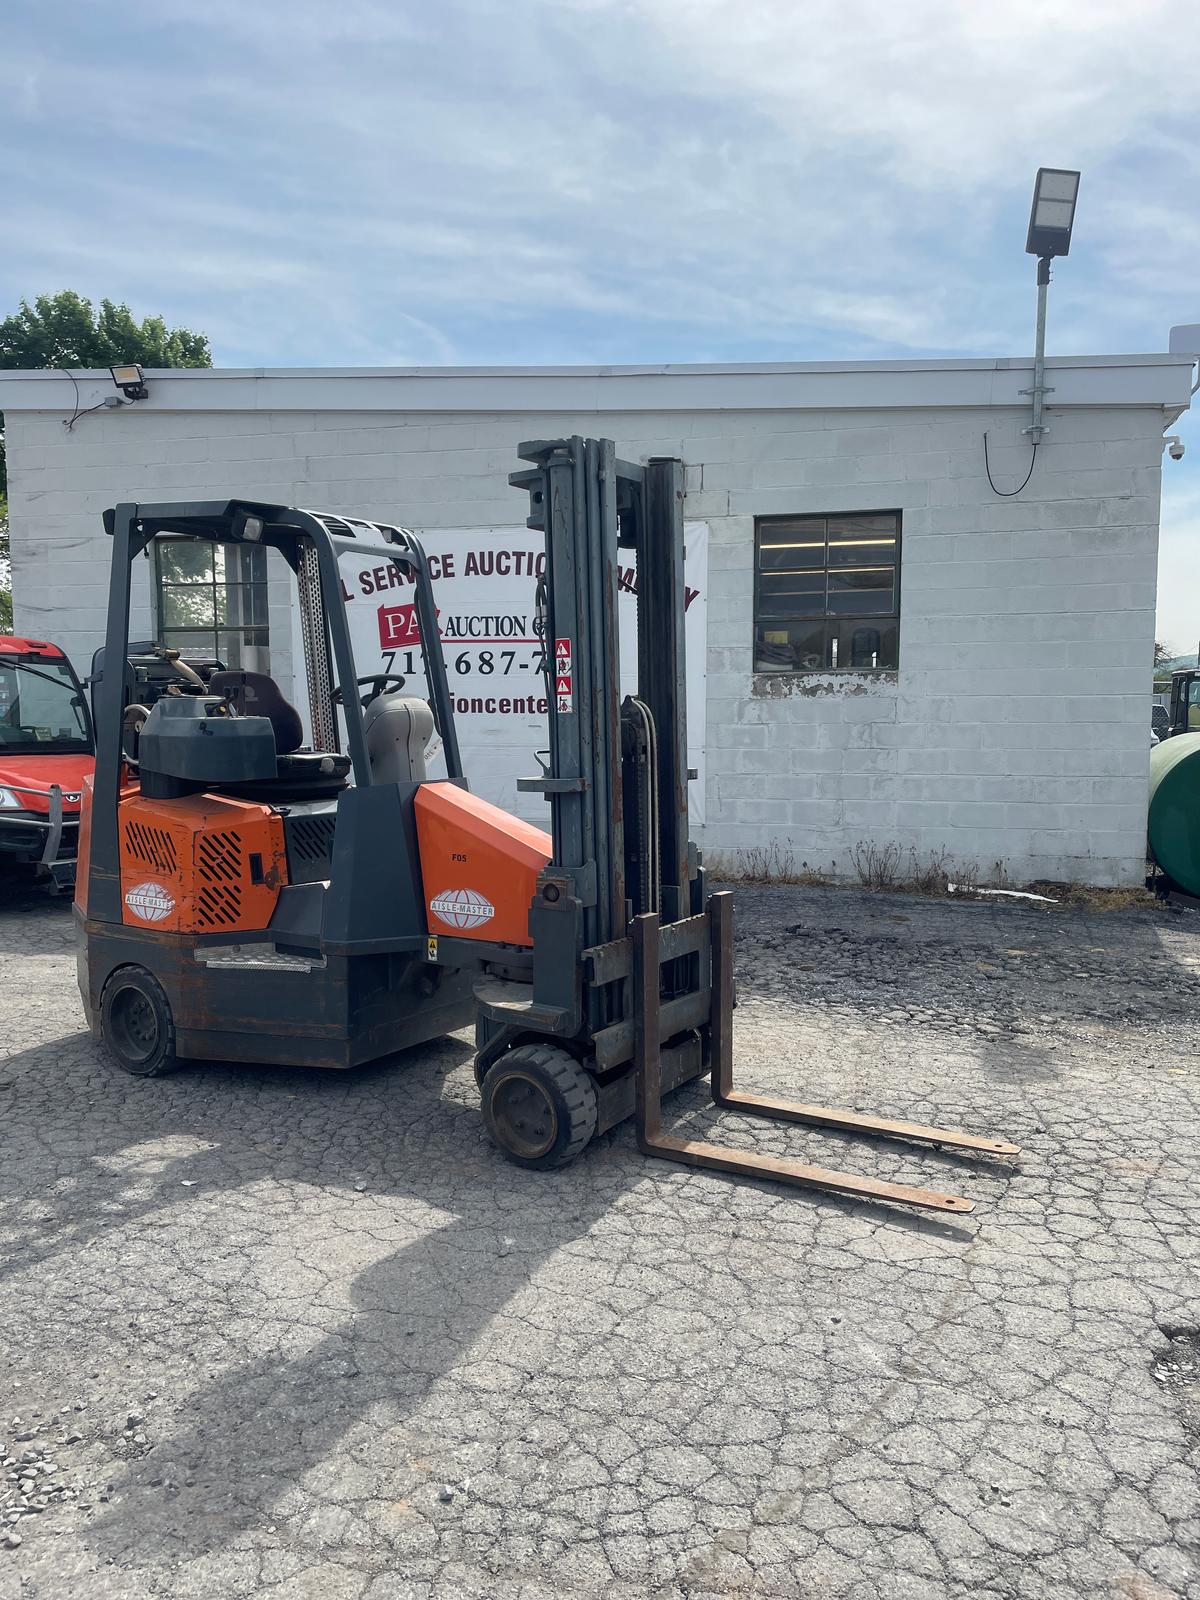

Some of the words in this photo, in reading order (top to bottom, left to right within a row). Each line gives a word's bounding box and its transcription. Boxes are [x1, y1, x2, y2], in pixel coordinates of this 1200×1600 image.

[358, 553, 455, 595] SERVCE
[464, 551, 546, 577] AUCTIO
[445, 616, 527, 637] AUCTION
[126, 895, 174, 909] AISLE-MASTE
[431, 902, 493, 916] AISLE-MASTER
